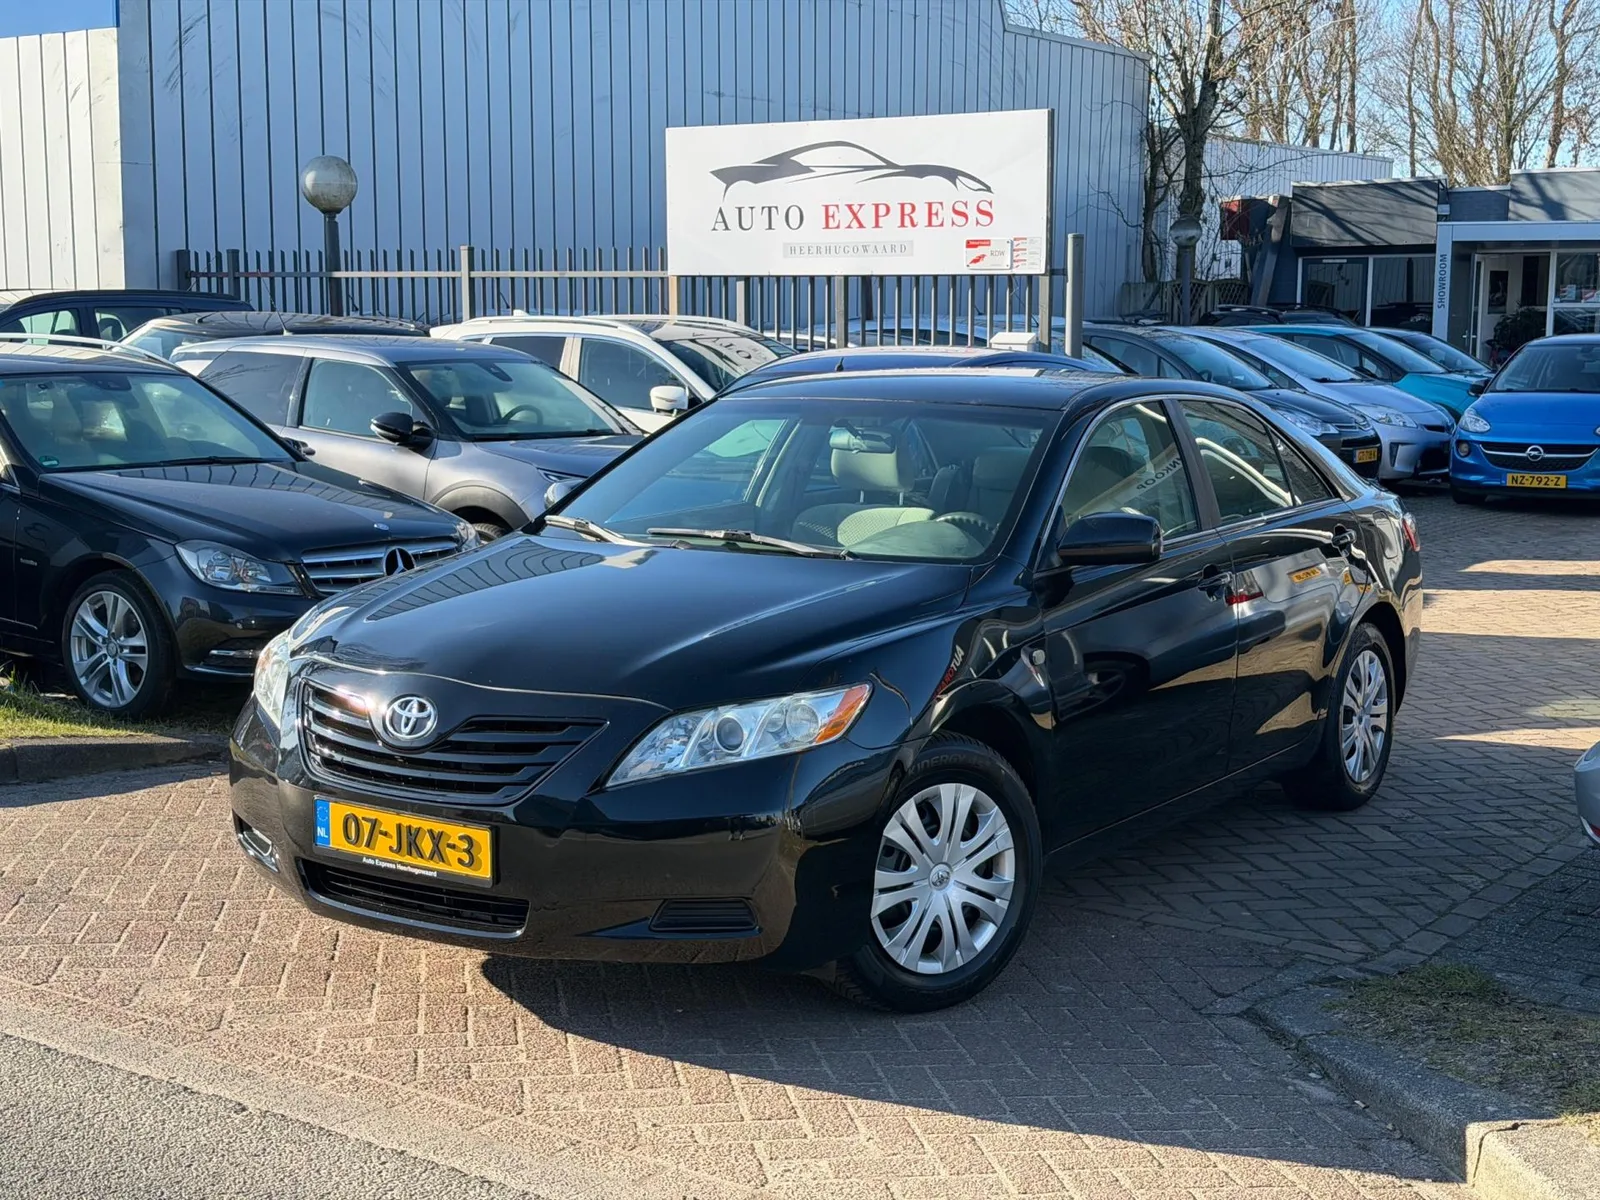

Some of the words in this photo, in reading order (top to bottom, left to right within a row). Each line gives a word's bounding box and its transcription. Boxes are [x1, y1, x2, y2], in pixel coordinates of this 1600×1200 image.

[711, 204, 805, 231] AUTO
[822, 199, 994, 229] EXPRESS
[788, 242, 909, 255] HEERHUGOWAARD
[1437, 253, 1448, 309] SHOWROOM
[1511, 475, 1561, 487] NZ-792-Z
[317, 826, 329, 838] NL
[342, 812, 476, 867] 07-JKX-3
[362, 856, 374, 865] Auto
[375, 859, 396, 869] Express
